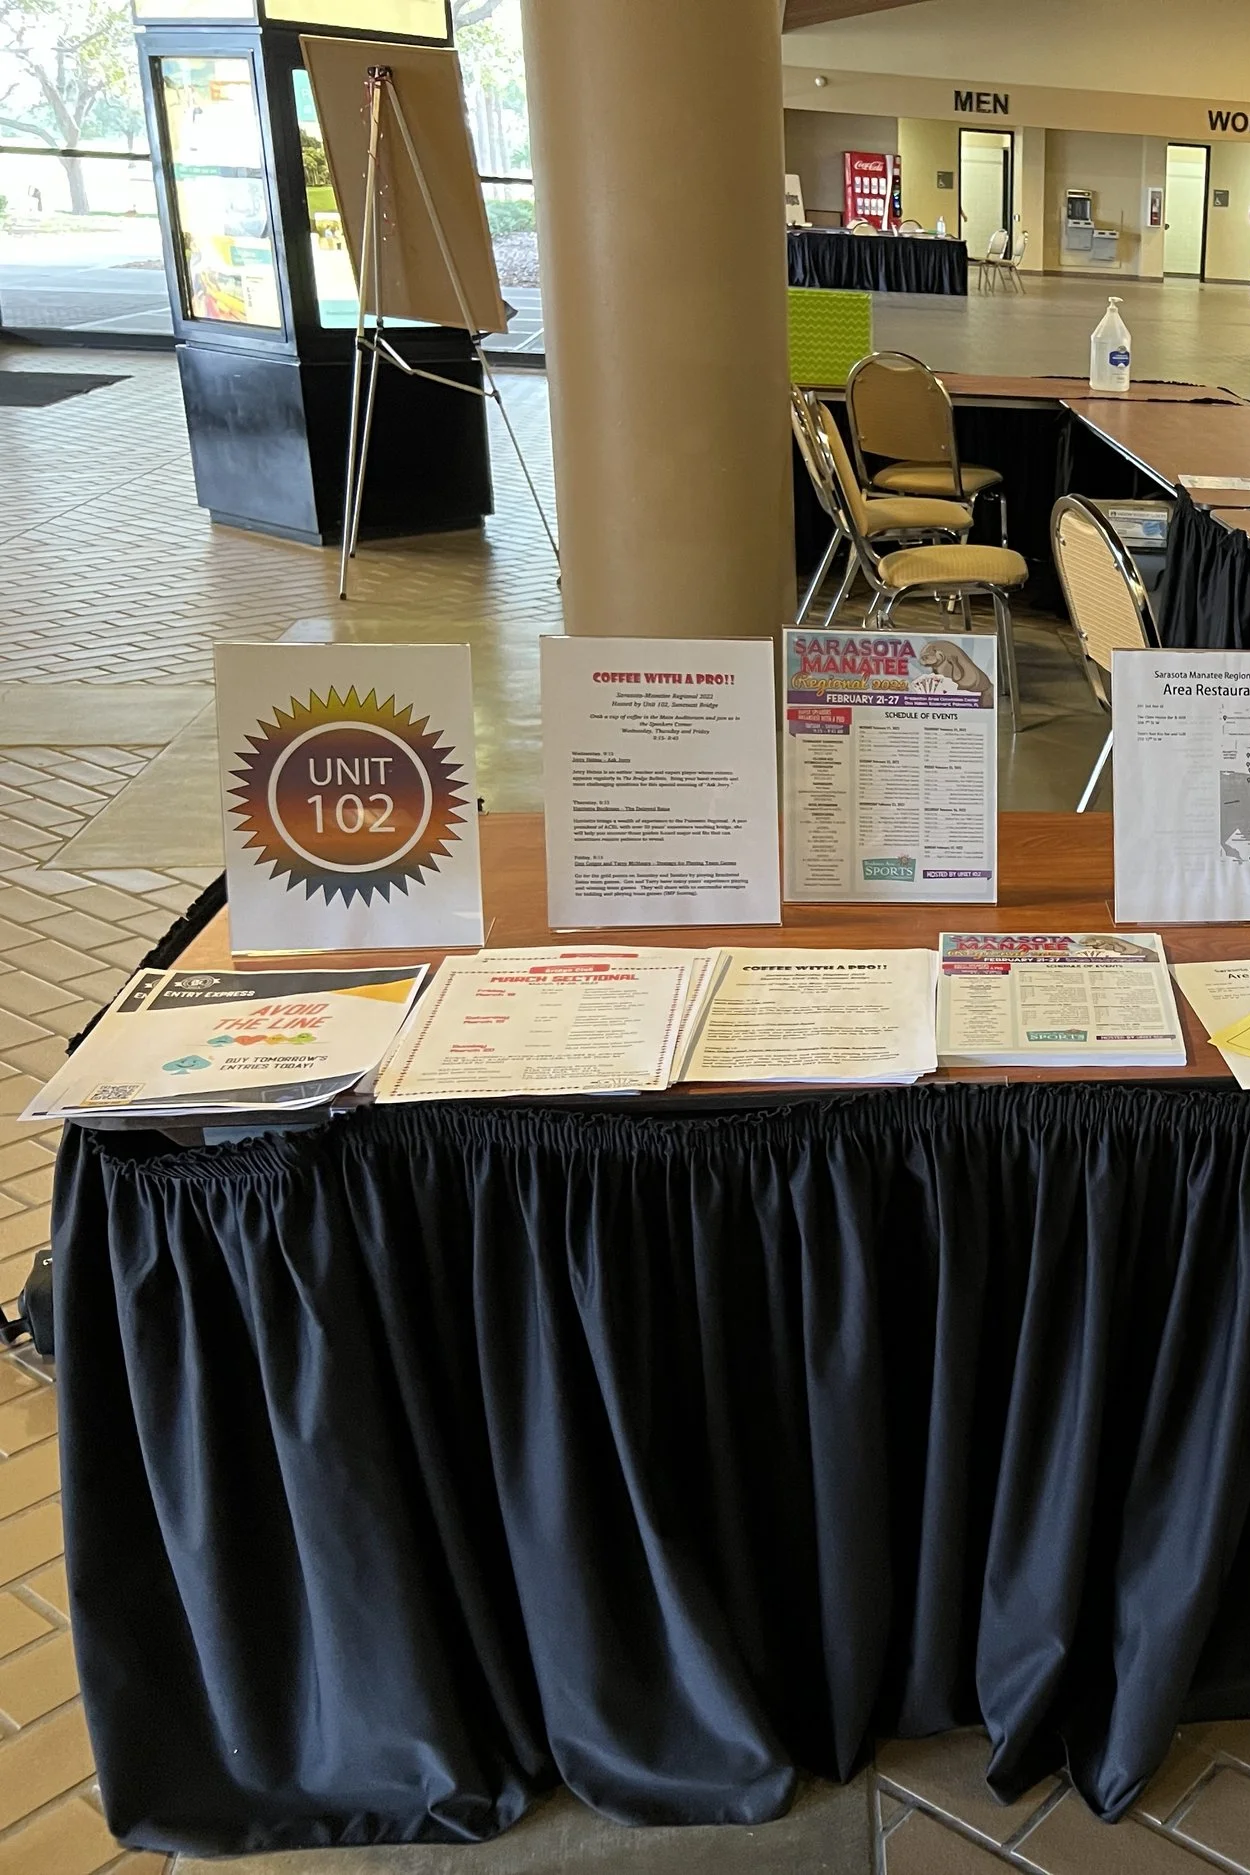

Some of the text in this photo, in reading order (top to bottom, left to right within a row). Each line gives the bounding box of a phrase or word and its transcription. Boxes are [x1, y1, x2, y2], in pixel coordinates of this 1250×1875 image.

[953, 90, 1010, 116] MEN
[854, 160, 885, 171] Coca-Cola
[794, 636, 916, 658] SARASOTA
[801, 655, 909, 676] MANATEE
[592, 672, 735, 685] COFFEE WITH A PRO!!
[1154, 671, 1188, 679] Sarasota
[791, 672, 872, 696] Regional
[1163, 684, 1192, 696] Area
[826, 694, 899, 705] FEBRUARY 21-27
[885, 711, 917, 719] SCHEDULE
[932, 712, 958, 720] EVENTS
[308, 757, 394, 787] UNIT
[306, 793, 396, 834] 102
[865, 865, 913, 877] SPORTS
[950, 935, 1076, 944] SARASOTA
[956, 942, 1070, 951] MANATEE
[551, 974, 640, 983] SECTIONAL
[163, 990, 255, 998] ENTRY EXPRESS
[250, 1003, 331, 1017] AVOID
[213, 1016, 332, 1031] THE LINE
[252, 1055, 329, 1064] TOMORROW'S
[219, 1062, 314, 1071] ENTRIES TODAY!
